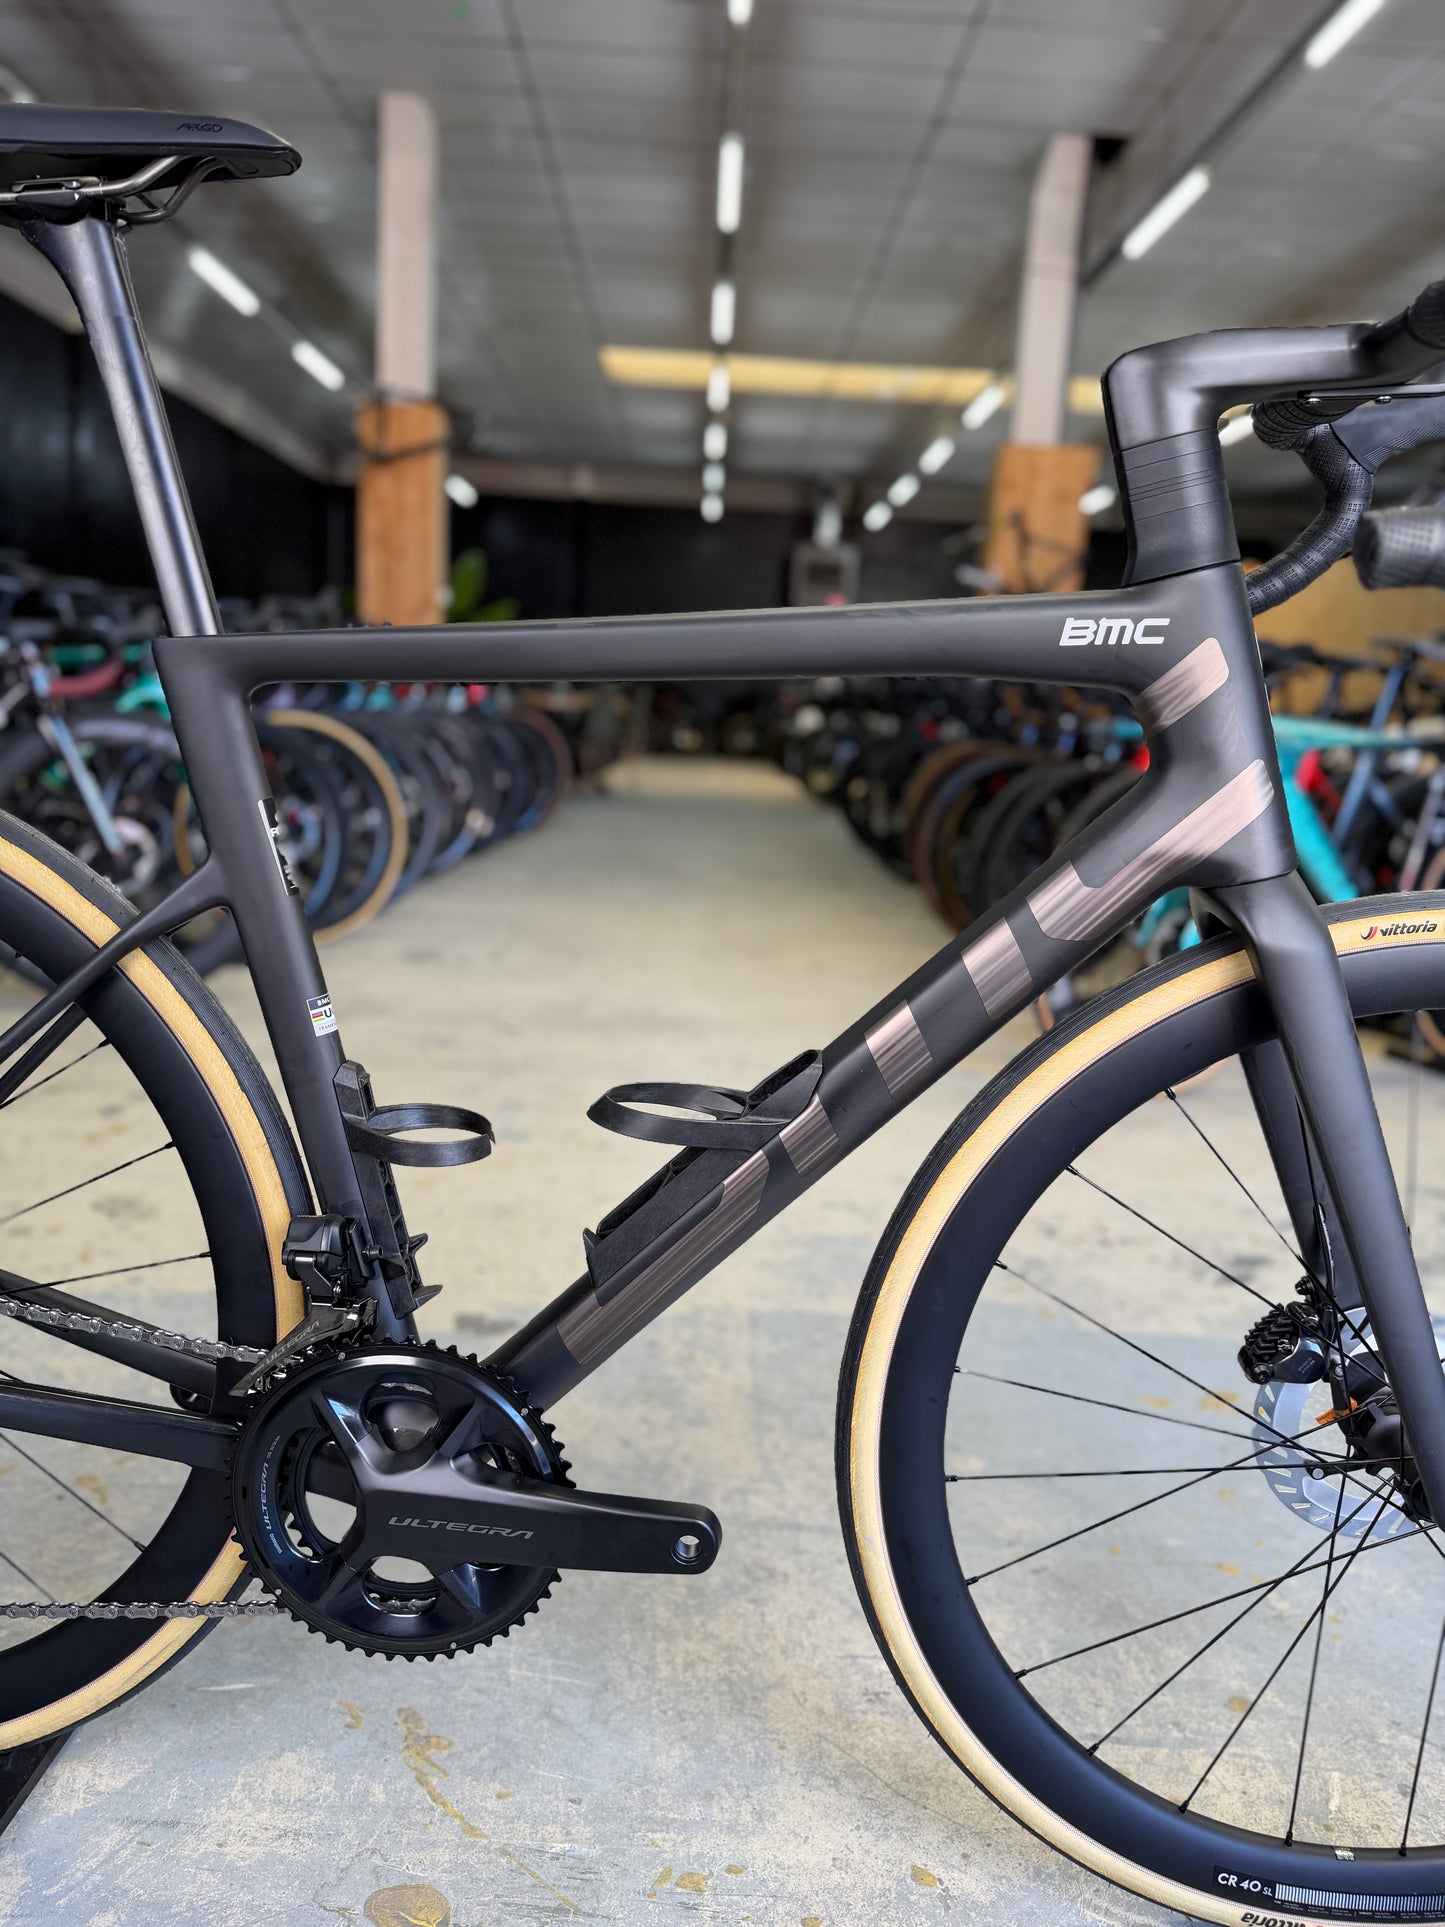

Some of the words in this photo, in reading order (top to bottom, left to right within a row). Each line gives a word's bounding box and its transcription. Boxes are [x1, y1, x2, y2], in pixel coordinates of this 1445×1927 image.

[176, 122, 223, 133] ARGO
[1059, 617, 1170, 646] BMC
[1380, 920, 1437, 936] vittoria
[266, 1320, 319, 1363] ULTEGRA
[261, 1462, 271, 1530] ULTEGRA
[389, 1516, 534, 1539] ULTEGRA
[1217, 1873, 1238, 1887] CR
[1240, 1879, 1261, 1892] 40
[1262, 1887, 1273, 1896] SL
